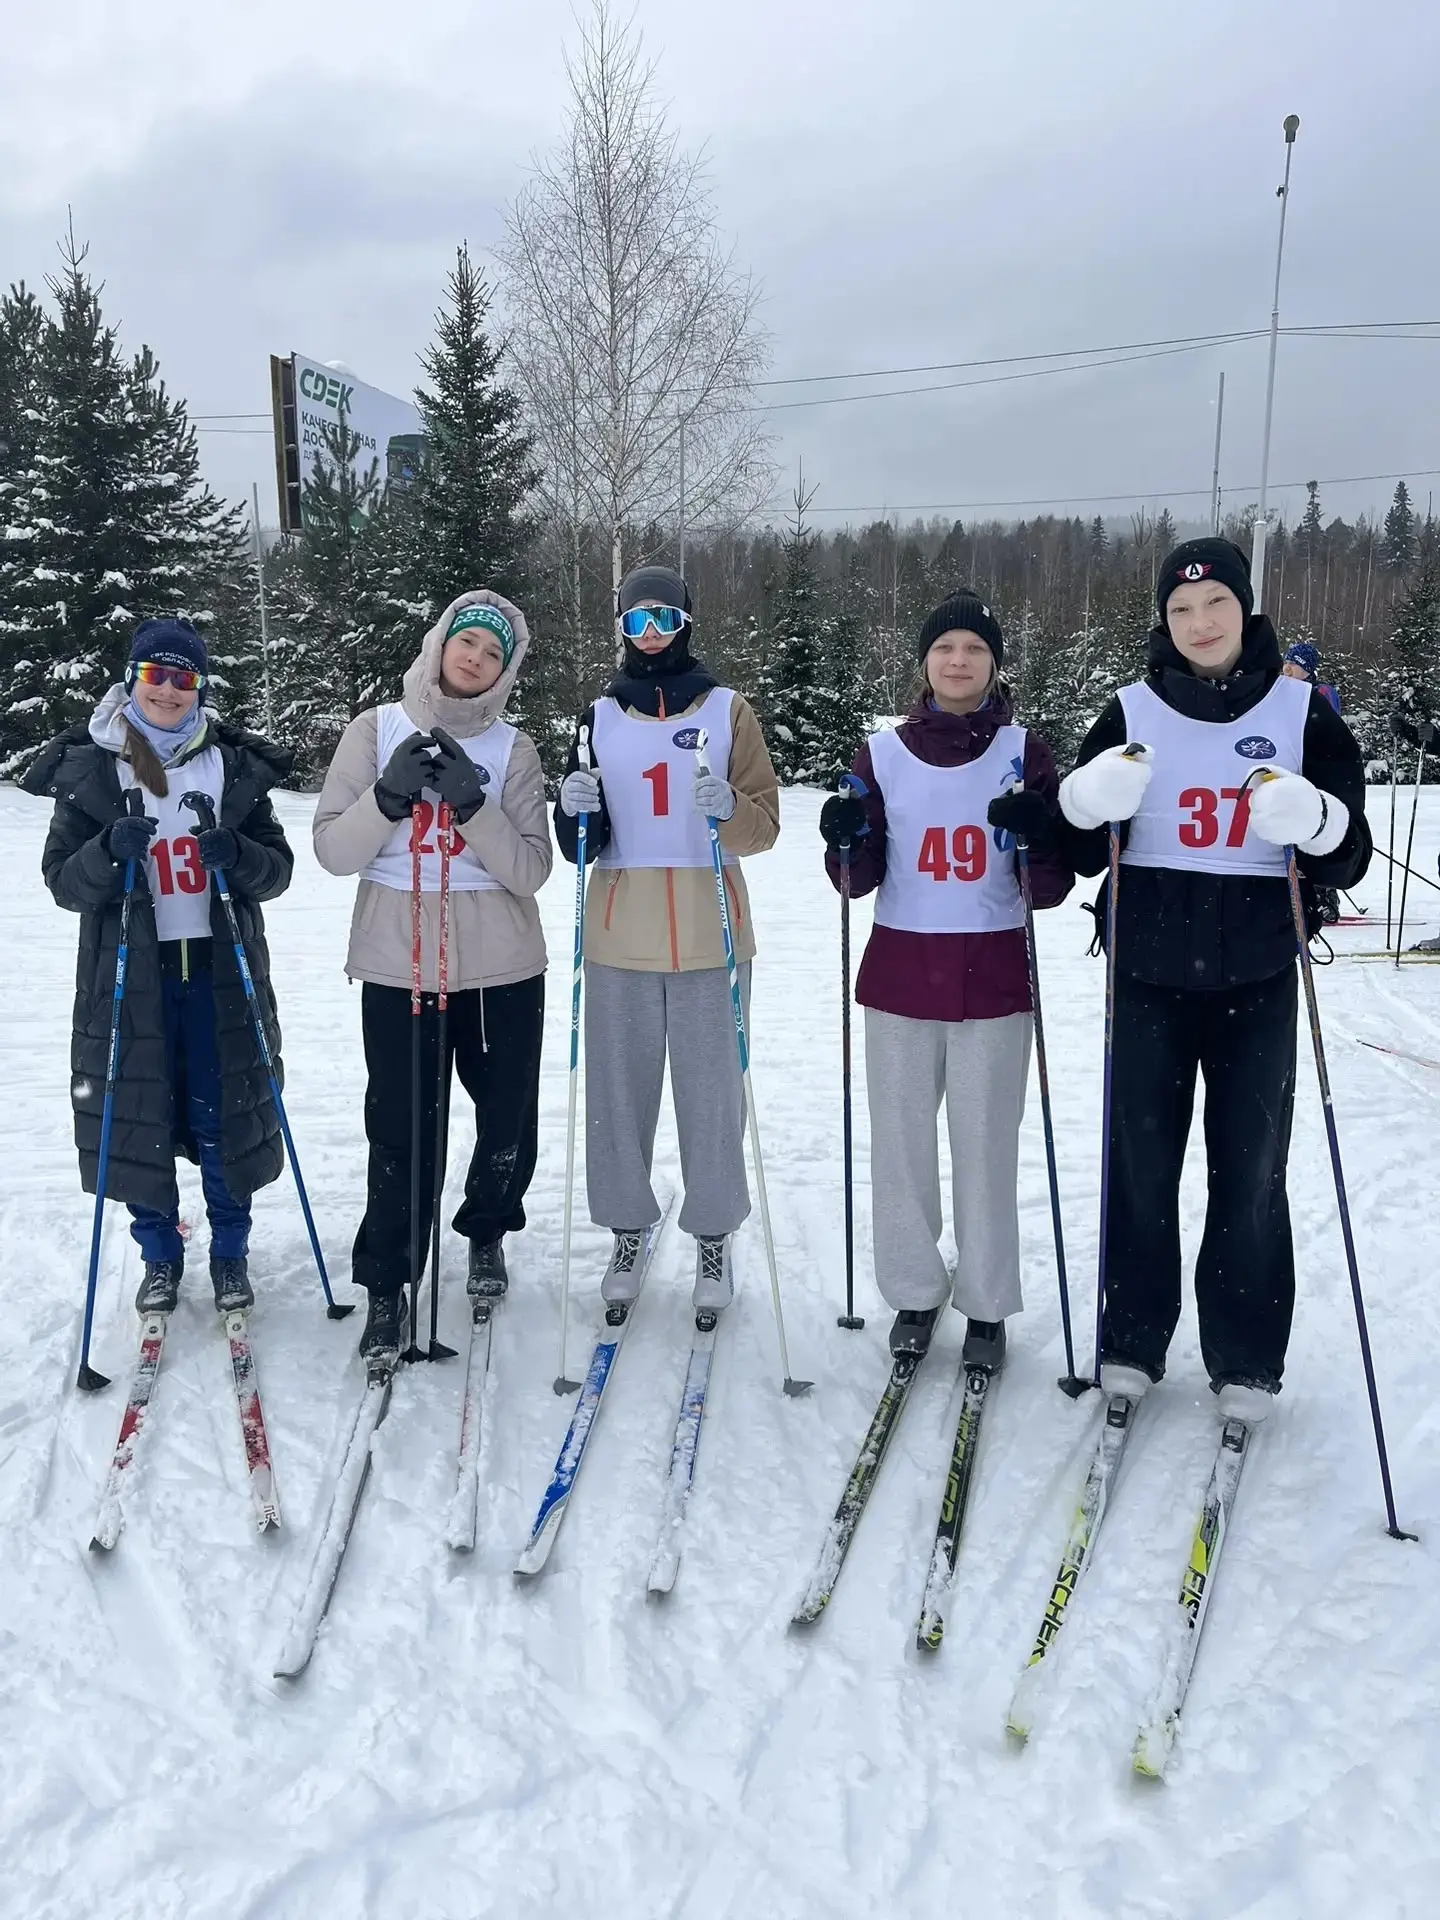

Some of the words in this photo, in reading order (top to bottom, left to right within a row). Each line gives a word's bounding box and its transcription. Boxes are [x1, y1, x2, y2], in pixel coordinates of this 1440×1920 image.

[300, 368, 354, 414] CDEK
[302, 411, 376, 450] КАЧЕСТЕННАЯ
[642, 762, 669, 816] 1
[1178, 787, 1254, 848] 37
[149, 836, 207, 895] 13
[918, 825, 987, 882] 49
